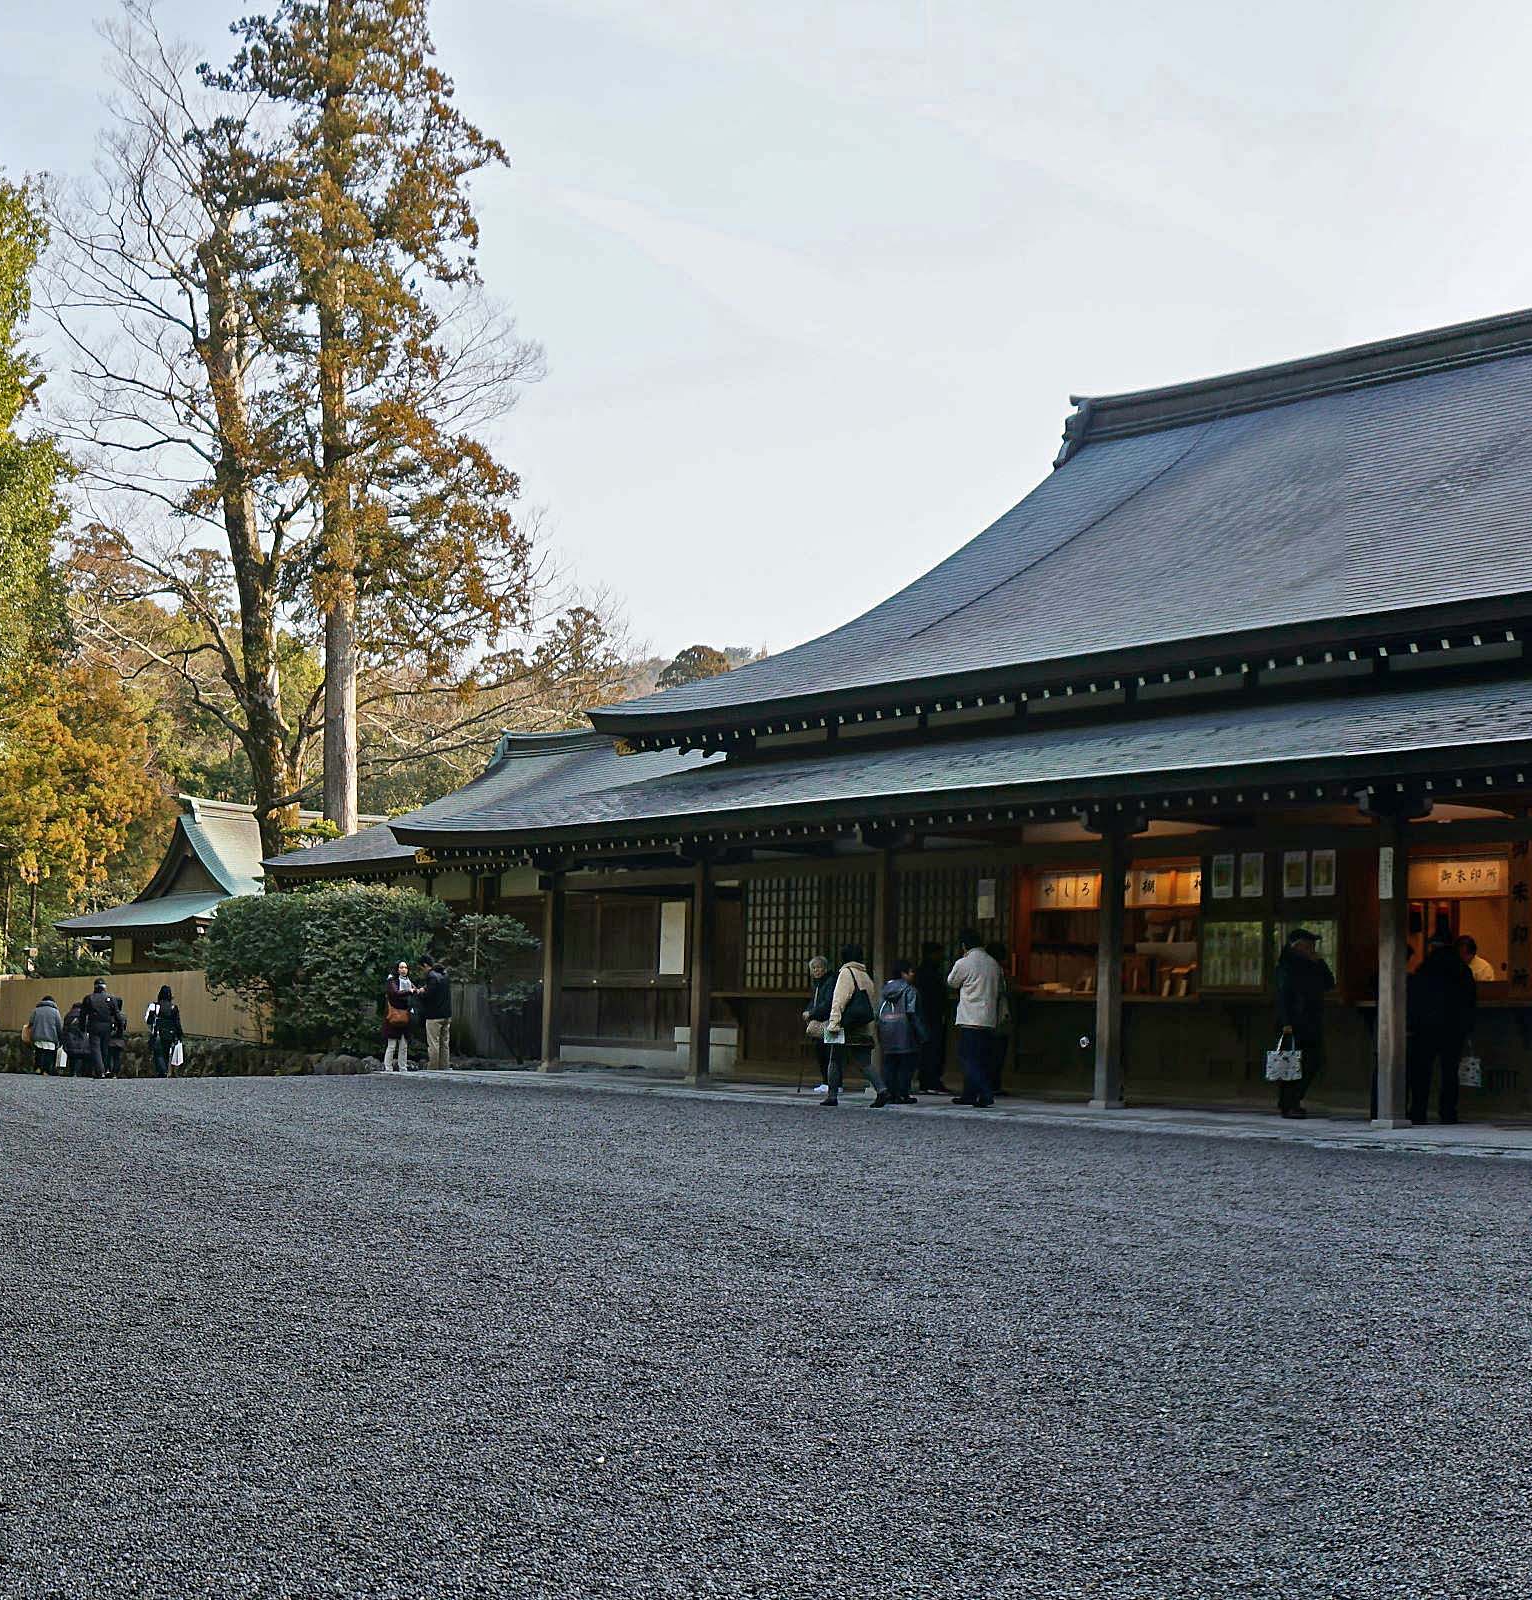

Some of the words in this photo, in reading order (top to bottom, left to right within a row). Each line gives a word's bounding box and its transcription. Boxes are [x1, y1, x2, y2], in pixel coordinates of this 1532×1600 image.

[1440, 866, 1499, 886] 御朱印所
[1044, 881, 1090, 898] やしろ
